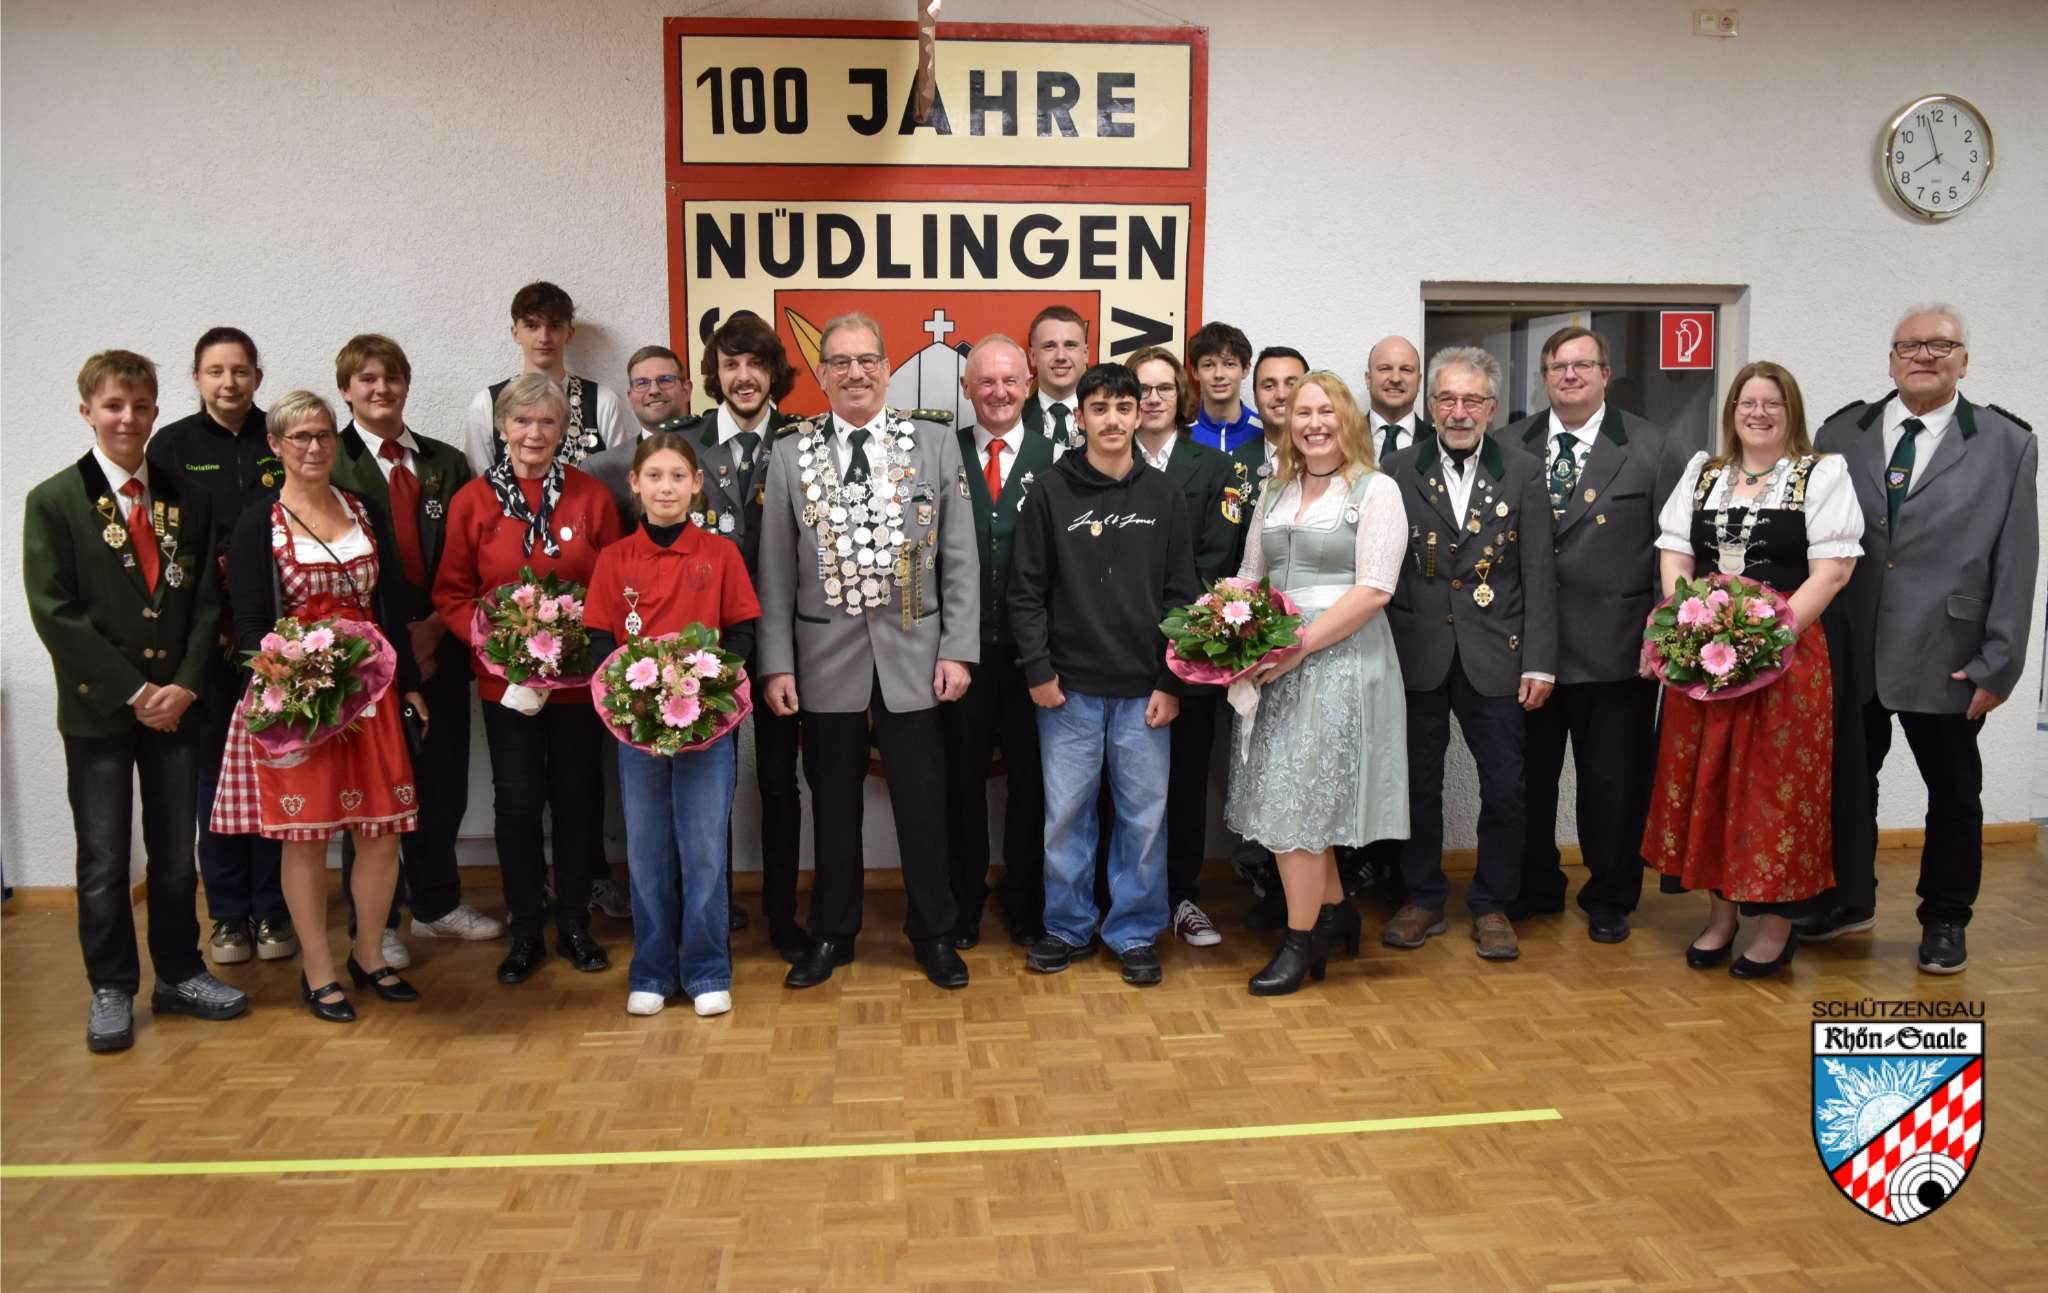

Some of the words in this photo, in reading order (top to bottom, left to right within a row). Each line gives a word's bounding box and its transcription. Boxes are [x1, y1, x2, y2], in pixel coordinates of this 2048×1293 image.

[696, 66, 808, 135] 100
[847, 68, 1136, 138] JAHRE
[1916, 114, 1926, 127] 11
[1931, 109, 1944, 123] 12
[1952, 114, 1958, 127] 1
[1901, 130, 1914, 144] 10
[1964, 129, 1973, 143] 2
[1895, 150, 1905, 164] 9
[1969, 149, 1978, 163] 3
[1901, 171, 1910, 184] 8
[1961, 170, 1971, 183] 4
[1916, 186, 1925, 200] 7
[1931, 191, 1941, 204] 6
[1948, 186, 1958, 199] 5
[696, 207, 1176, 281] NÜDLINGEN
[186, 463, 220, 471] Christine
